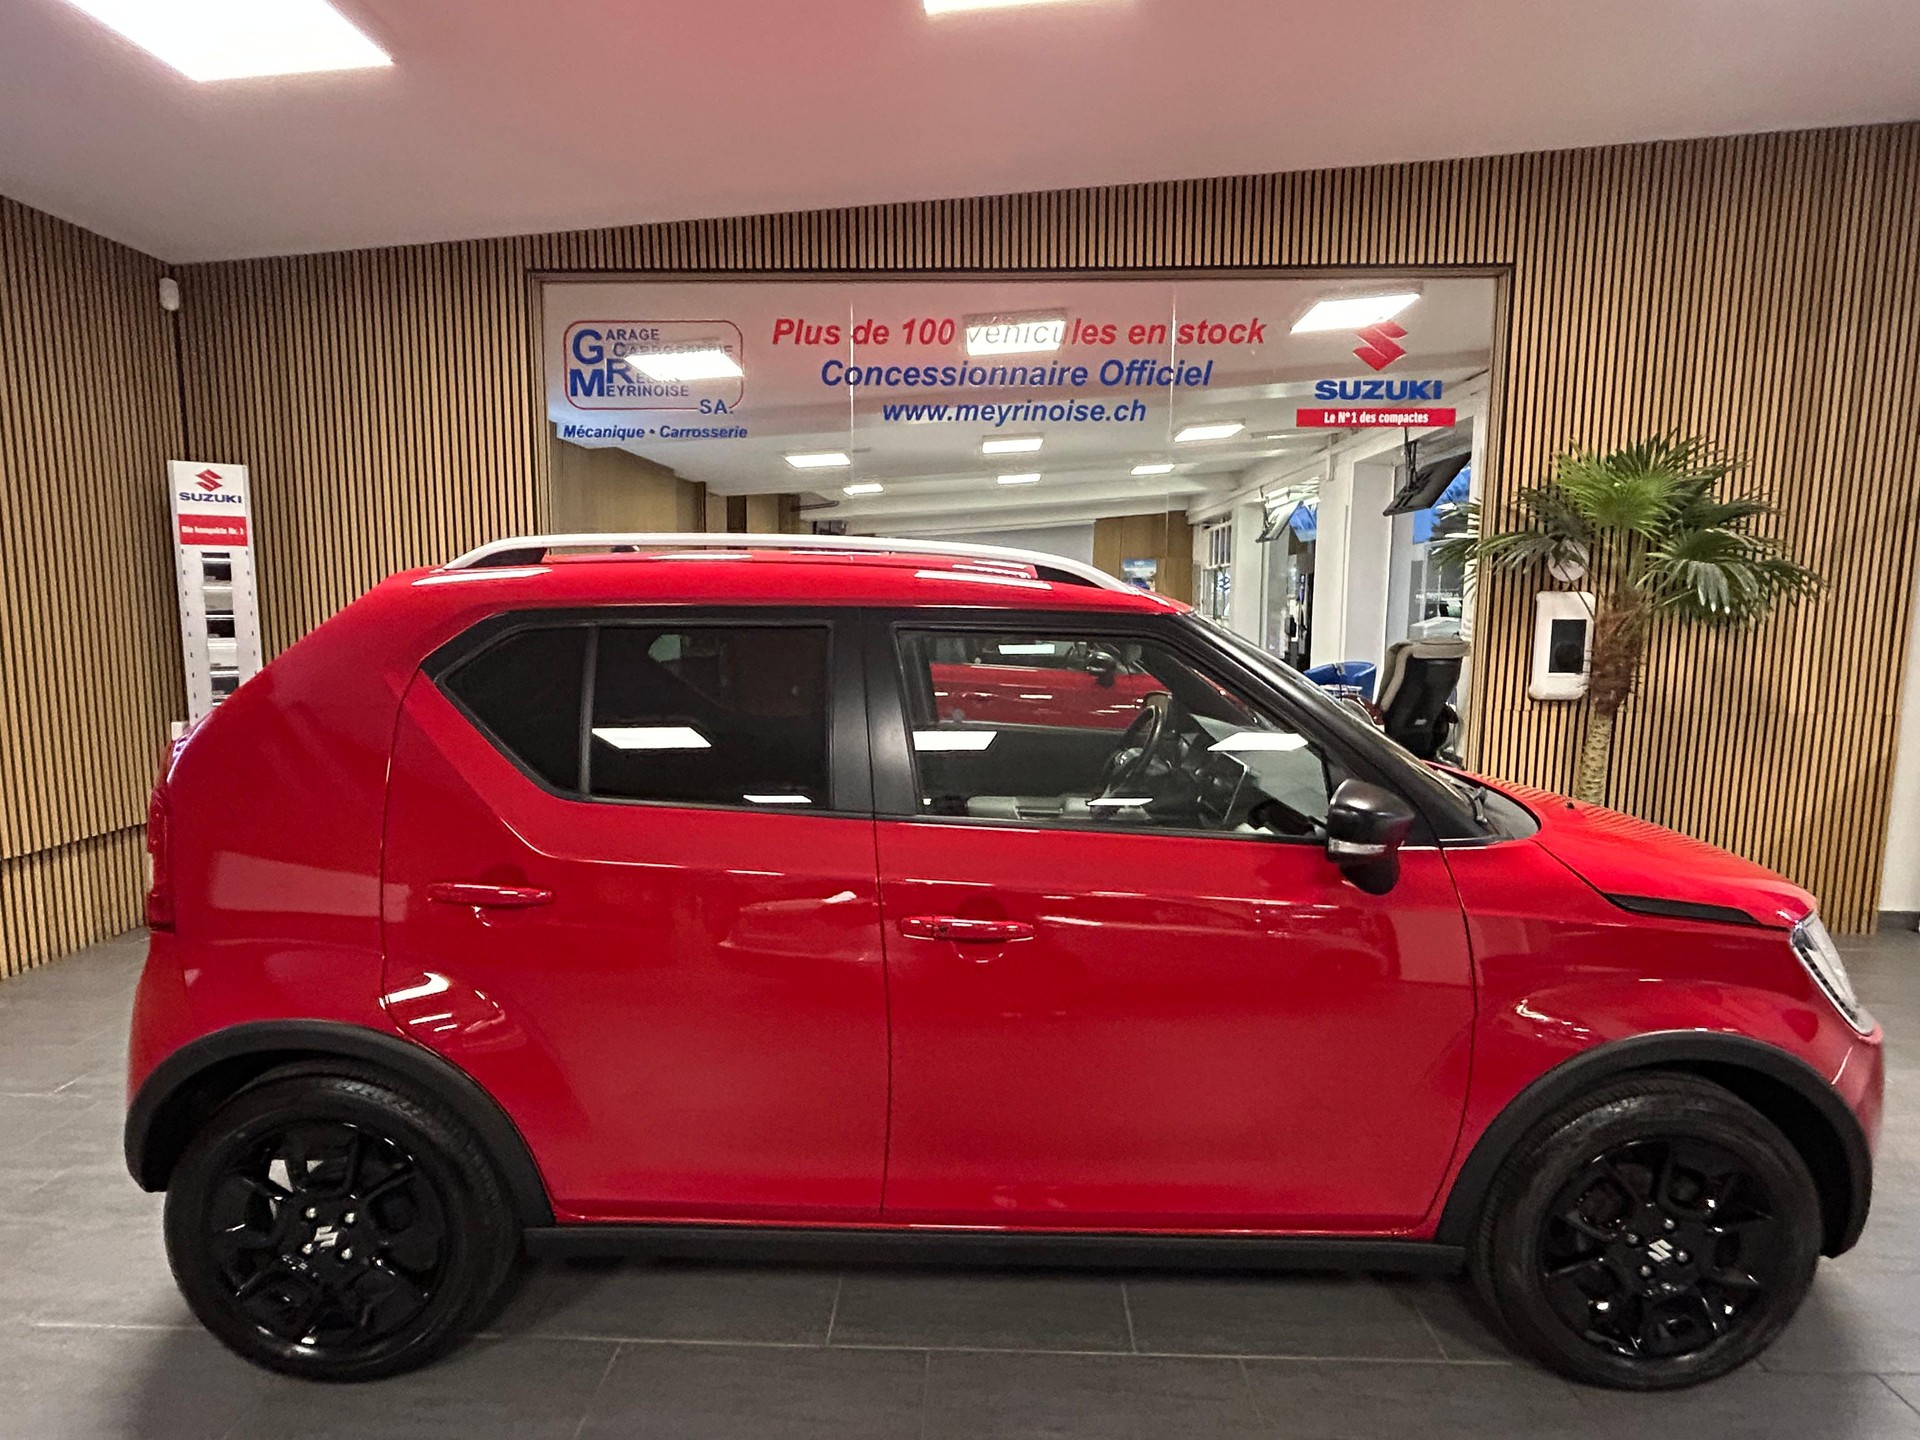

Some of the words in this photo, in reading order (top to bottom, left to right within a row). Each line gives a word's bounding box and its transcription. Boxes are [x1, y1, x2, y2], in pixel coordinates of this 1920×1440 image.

[772, 318, 841, 345] Plus
[852, 319, 890, 345] de
[902, 318, 956, 345] 100
[1128, 323, 1166, 345] en
[1176, 318, 1268, 345] stock
[821, 359, 1088, 387] Concessionnaire
[1099, 359, 1214, 387] Officiel
[1314, 379, 1443, 400] SUZUKI
[882, 400, 1147, 428] www.meyrinoise.ch
[1324, 412, 1336, 424] Le
[1359, 411, 1376, 424] des
[1378, 411, 1429, 426] compactes
[563, 424, 646, 441] Mécanique
[659, 424, 749, 439] Carrosserie
[179, 492, 243, 504] SUZUKI
